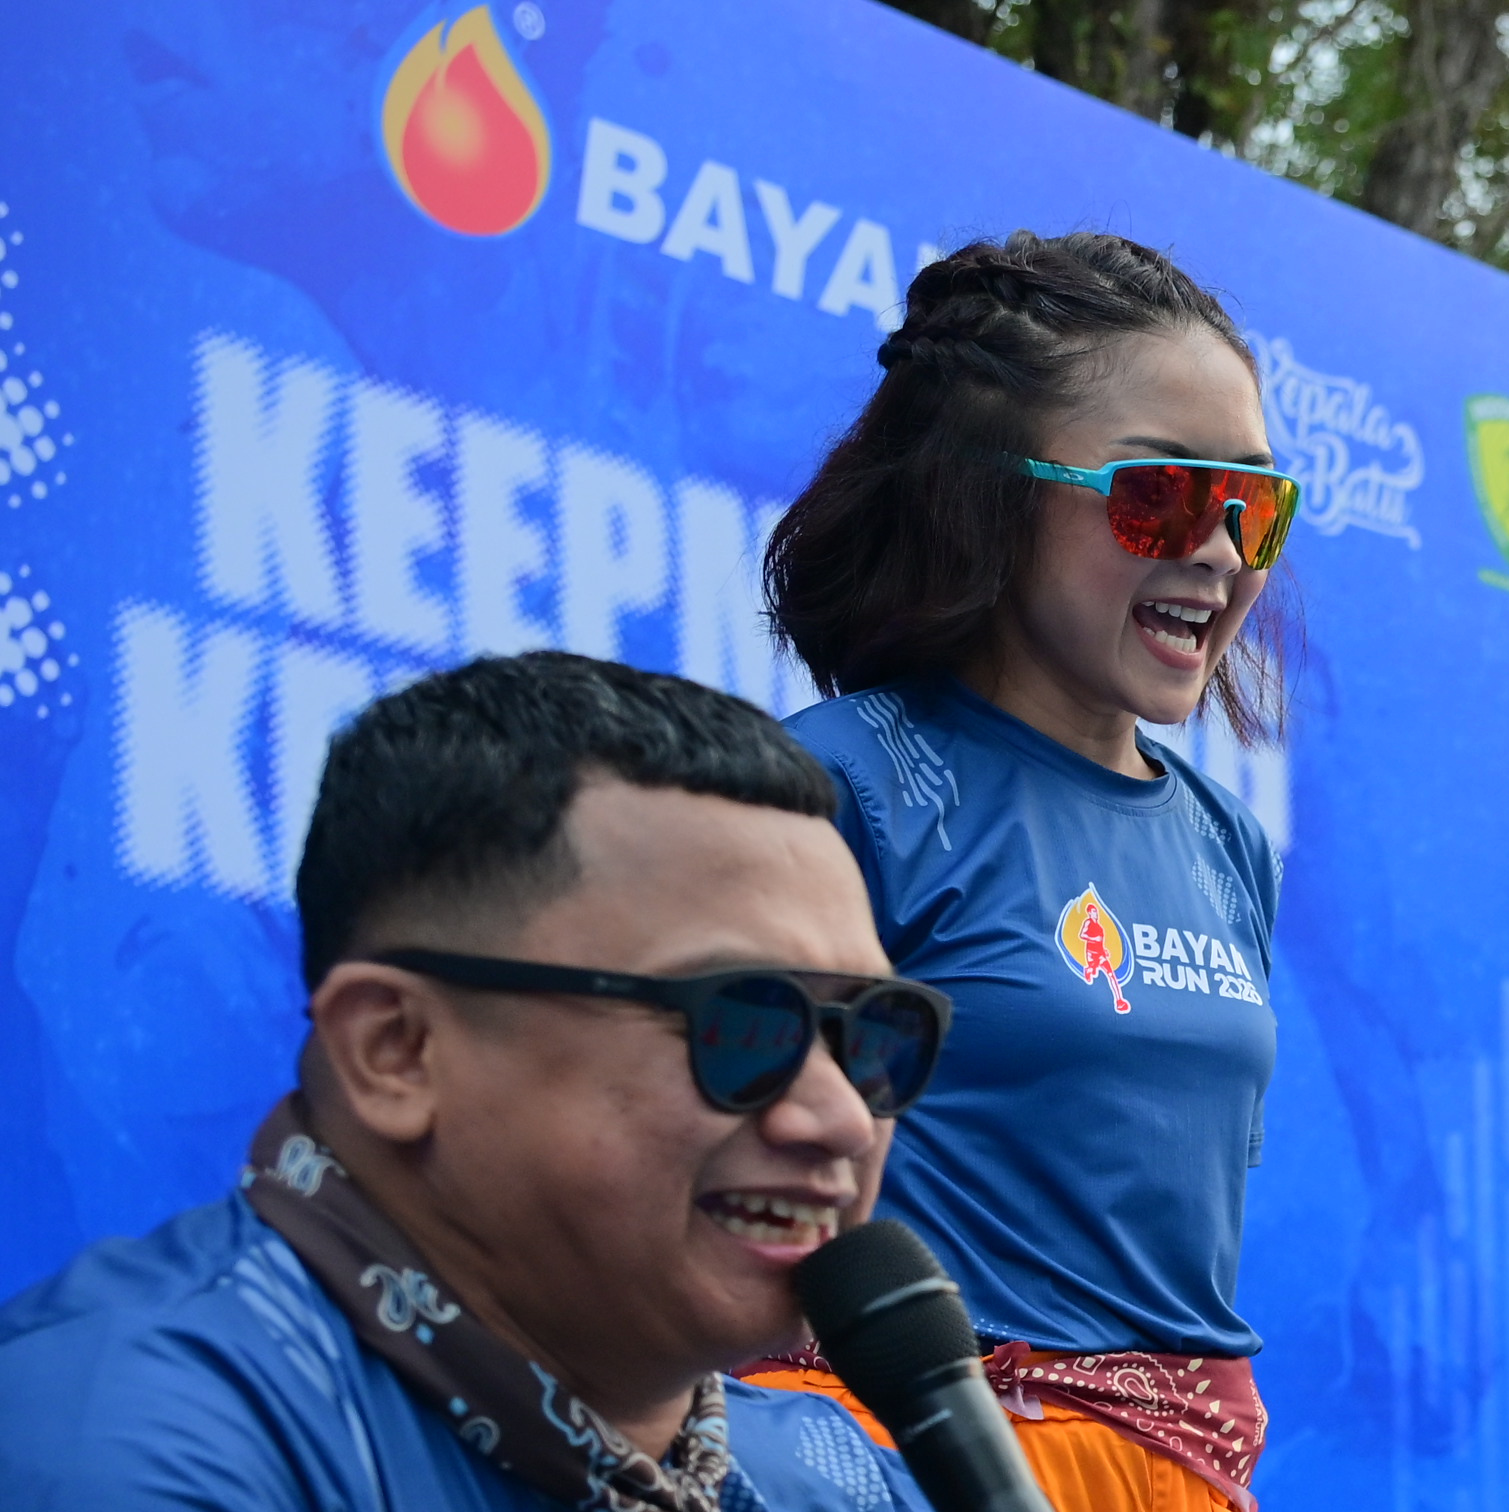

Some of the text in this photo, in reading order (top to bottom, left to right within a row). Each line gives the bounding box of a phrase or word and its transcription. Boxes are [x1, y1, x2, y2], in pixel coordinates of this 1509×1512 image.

[575, 115, 940, 335] BAYA
[1132, 922, 1252, 982] BAYAN
[1136, 958, 1264, 1007] RUN 2026
